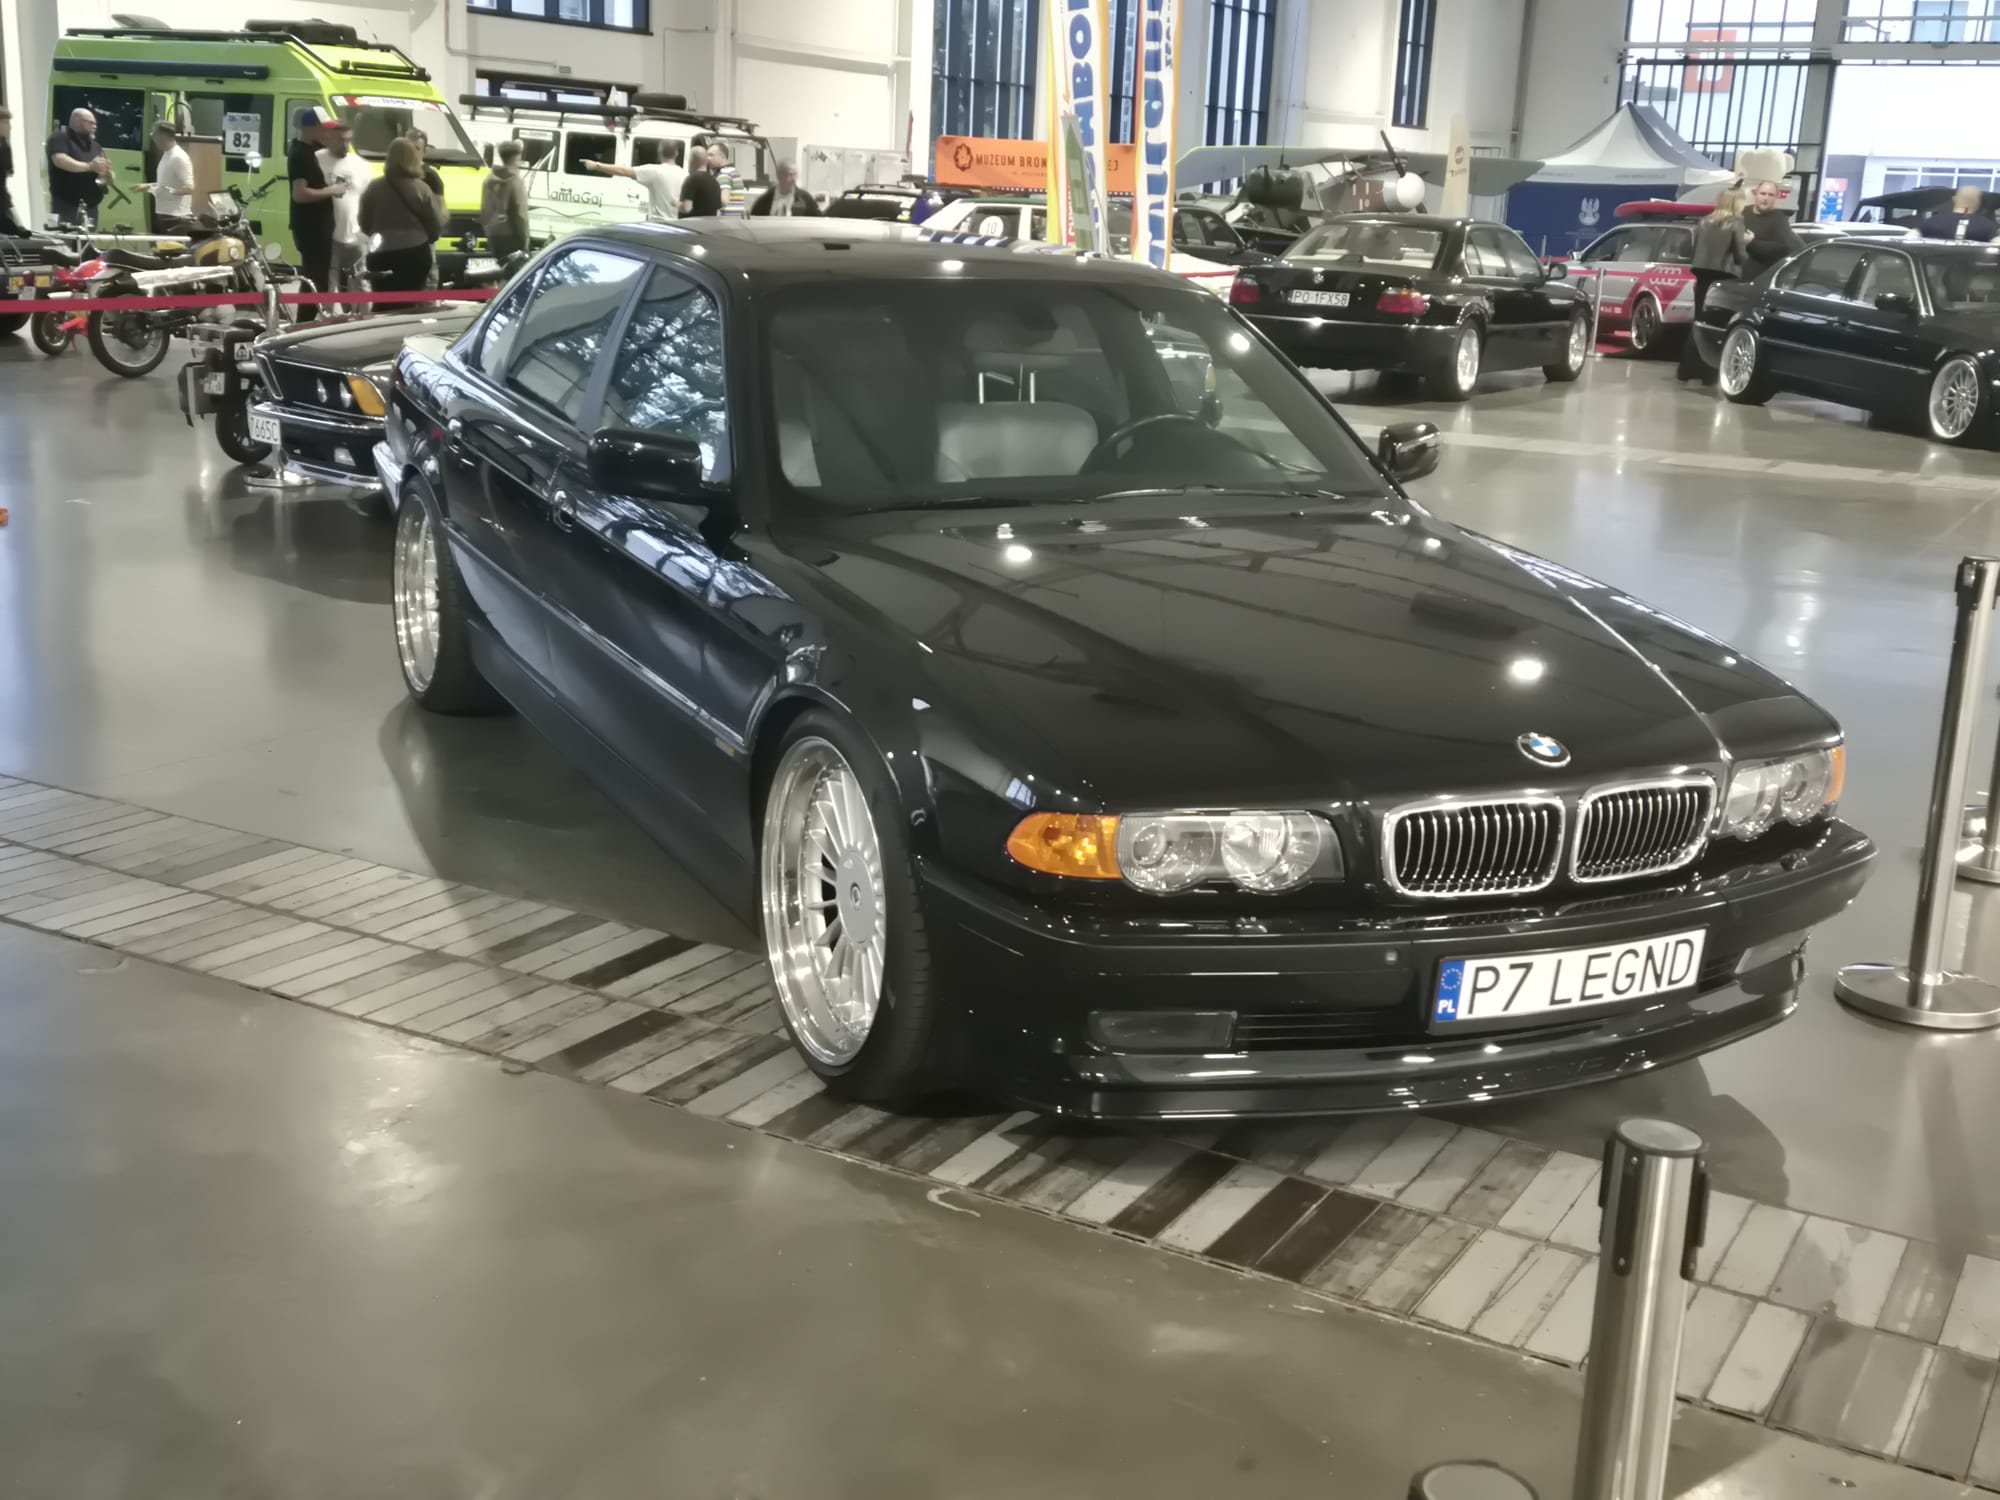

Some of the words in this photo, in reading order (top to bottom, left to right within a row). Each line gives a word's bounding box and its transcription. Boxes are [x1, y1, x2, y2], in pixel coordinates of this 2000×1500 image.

[233, 132, 251, 149] 82
[976, 153, 1015, 167] MUZEUM
[1019, 155, 1047, 169] BRON
[986, 222, 998, 235] 10
[1467, 961, 1534, 1015] P7
[1548, 938, 1695, 1006] LEGND
[1438, 999, 1456, 1014] PL
